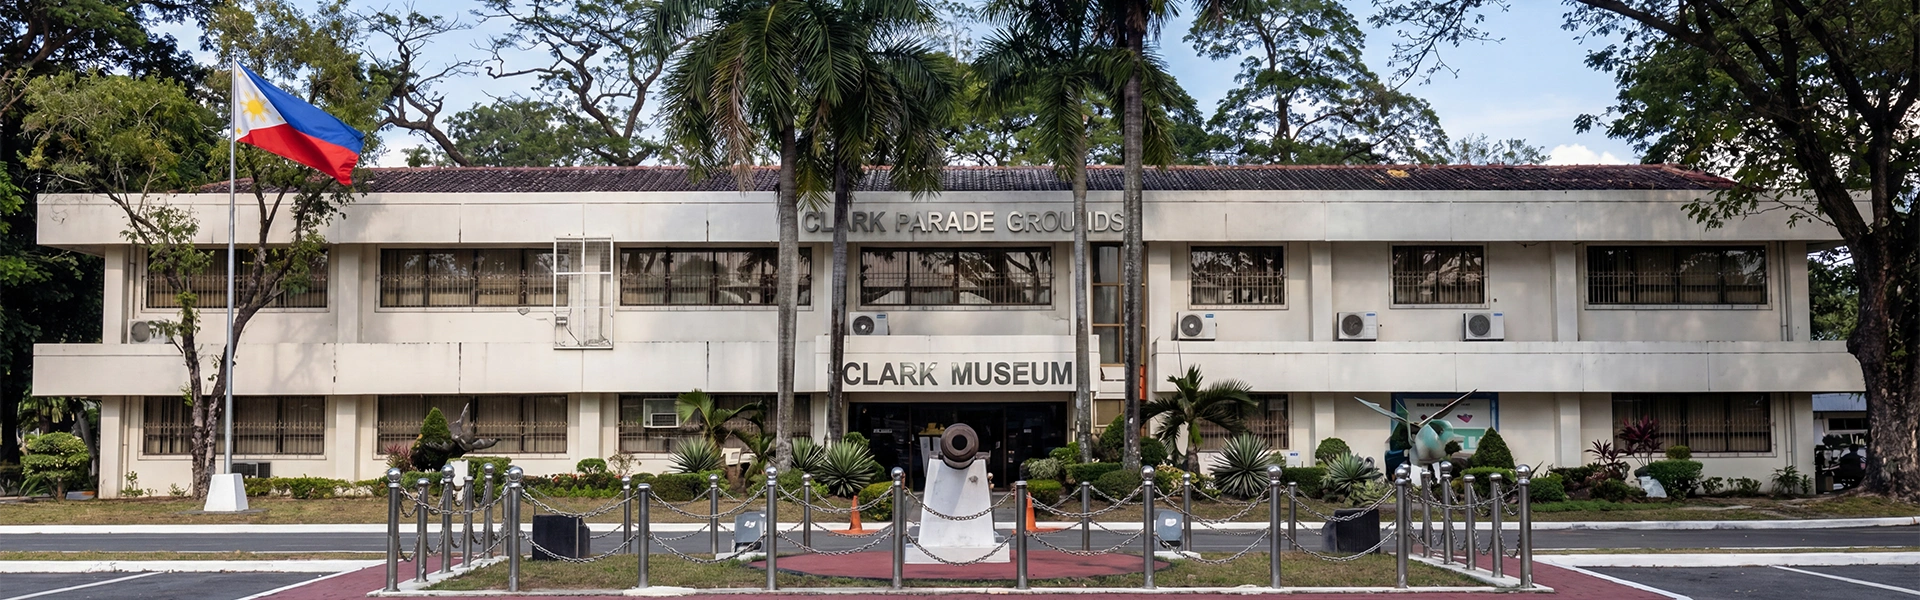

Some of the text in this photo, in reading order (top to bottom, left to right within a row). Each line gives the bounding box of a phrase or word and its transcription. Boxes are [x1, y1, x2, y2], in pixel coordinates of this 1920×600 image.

[895, 211, 995, 233] PARADE
[843, 361, 1073, 386] CLARK MUSEUM
